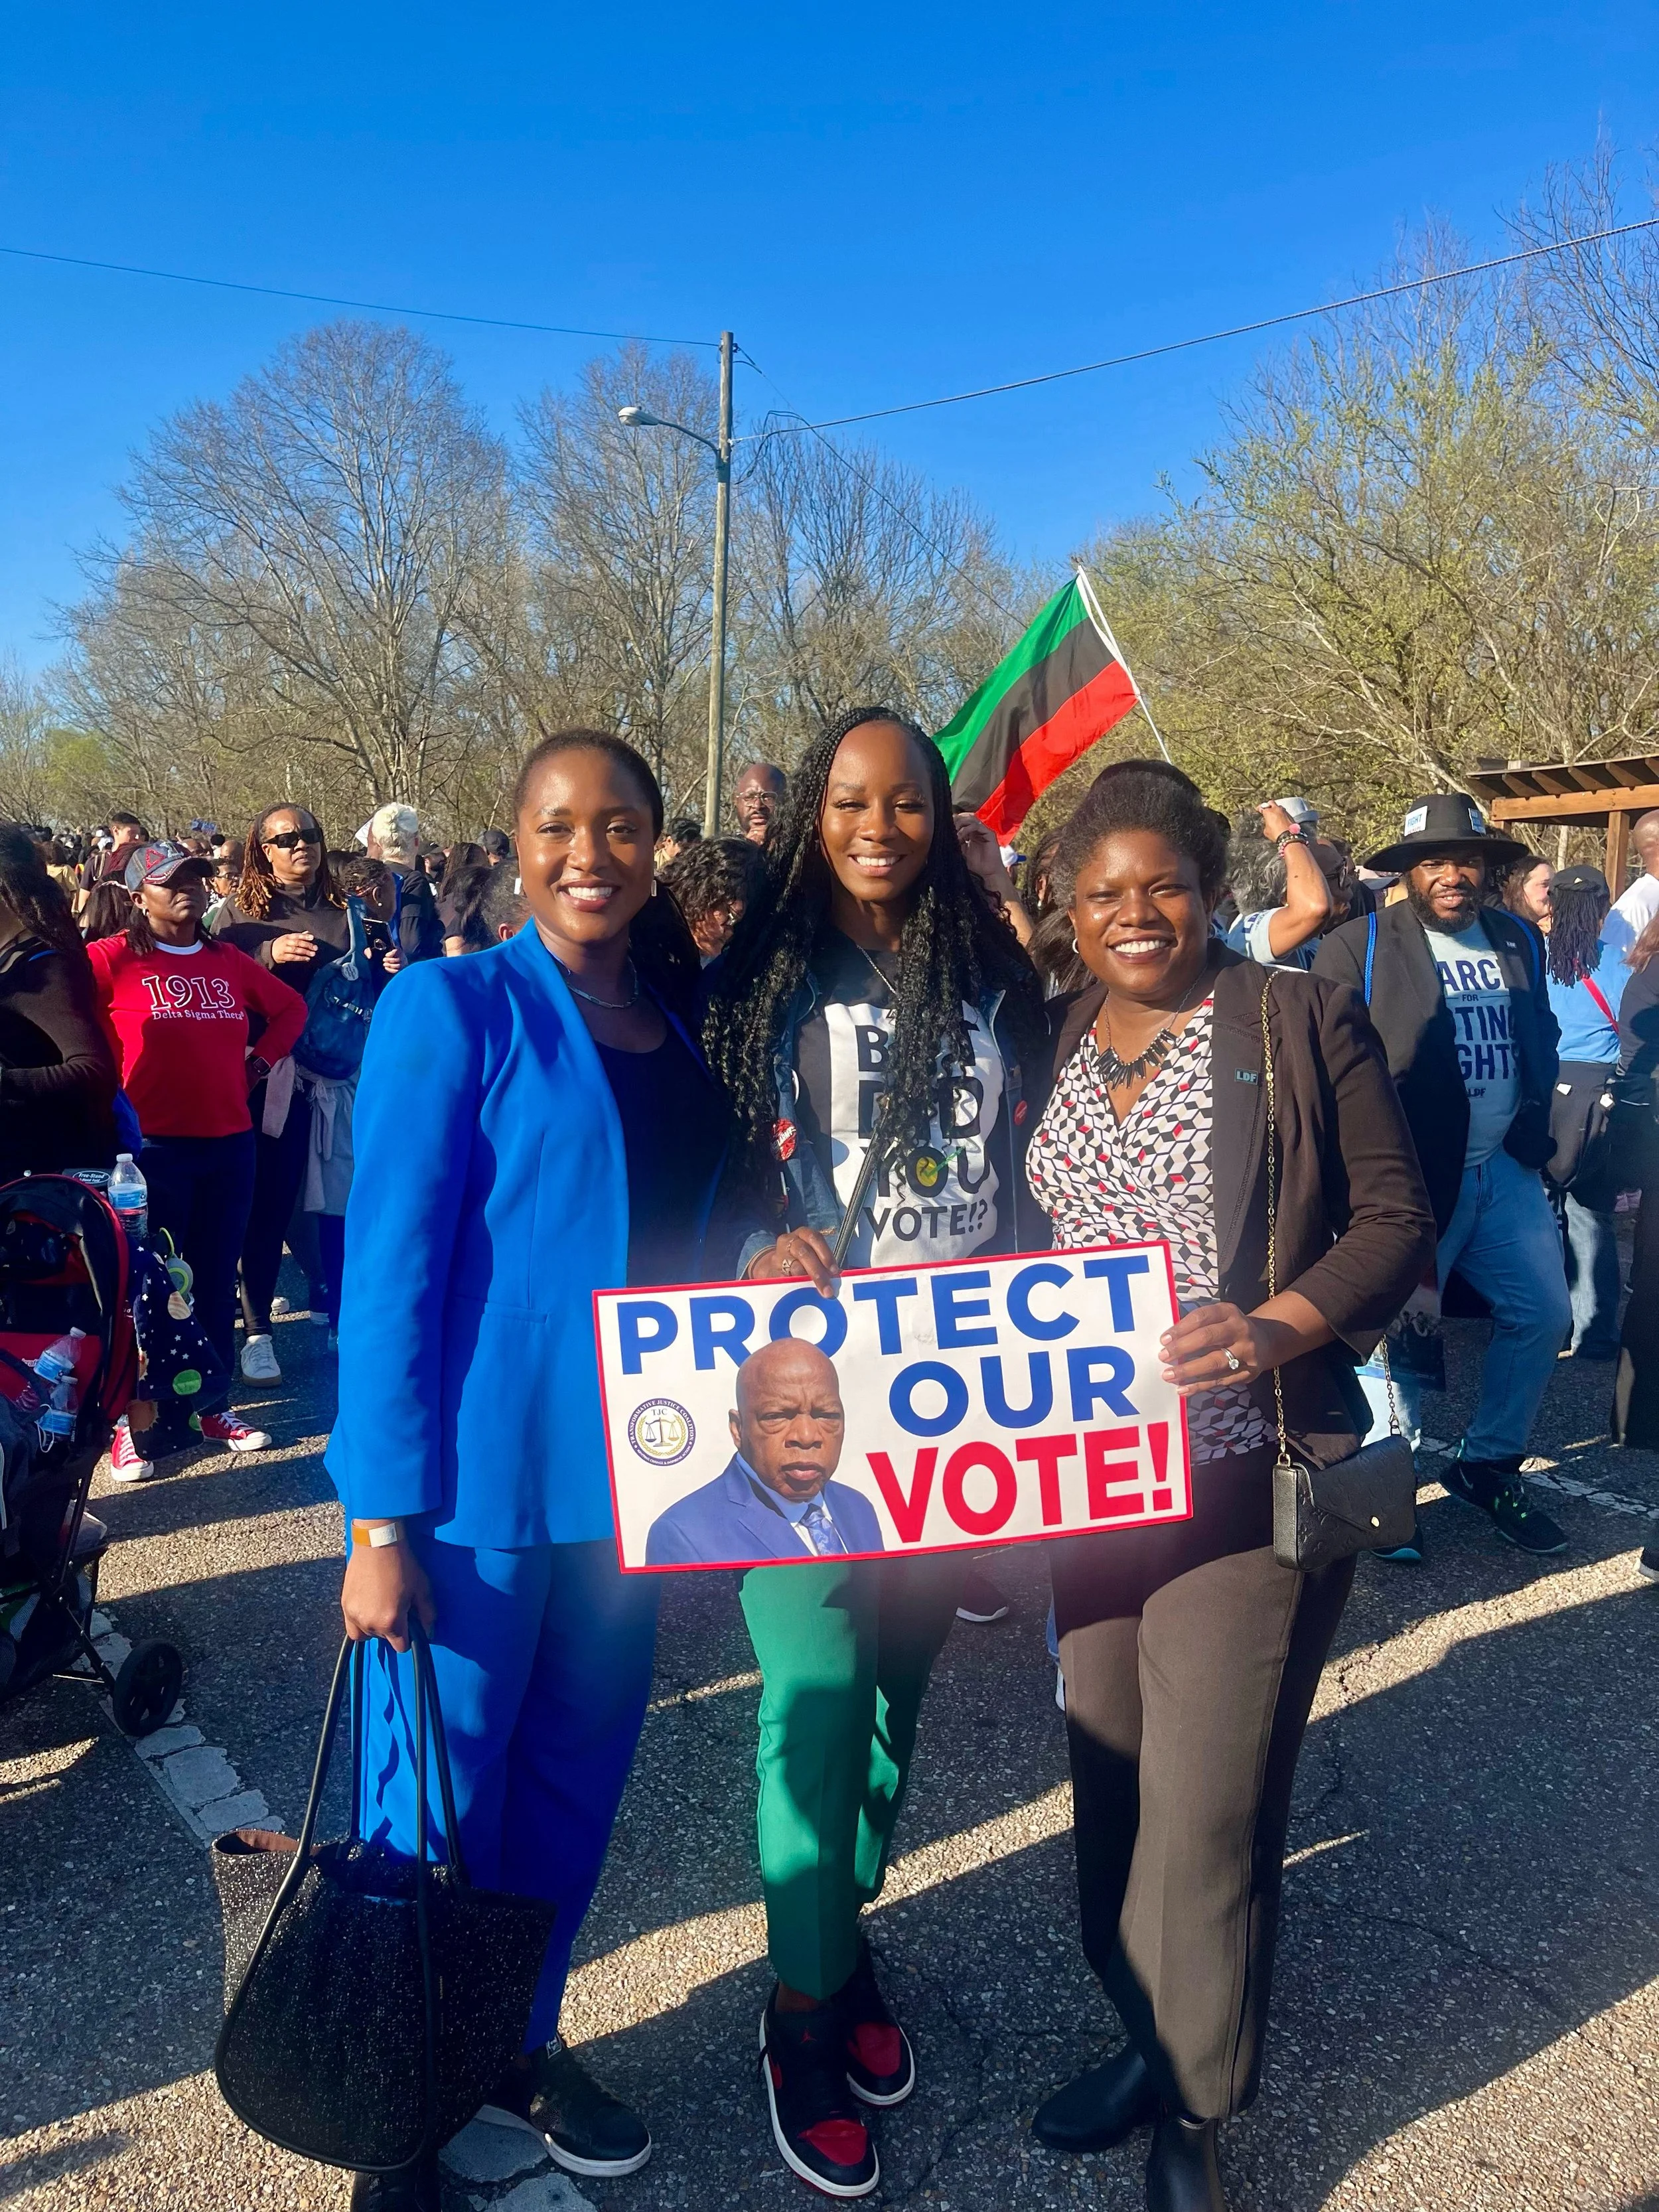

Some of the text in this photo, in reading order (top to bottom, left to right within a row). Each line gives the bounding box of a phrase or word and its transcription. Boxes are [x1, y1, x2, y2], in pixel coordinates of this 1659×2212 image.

[142, 975, 236, 1011] 1913
[1437, 959, 1501, 992] ARC
[153, 1009, 183, 1020] Delta
[184, 1009, 216, 1021] Sigma
[1455, 1004, 1508, 1041] TIN
[1236, 1070, 1257, 1082] LDF
[1455, 1043, 1510, 1080] GHT
[863, 1198, 989, 1242] VOTE!?
[617, 1255, 1149, 1375] PROTECT
[889, 1345, 1141, 1438] OUR
[630, 1399, 694, 1444] TRANSFORMATIVE JUSTICE COALITION
[865, 1422, 1173, 1543] VOTE!
